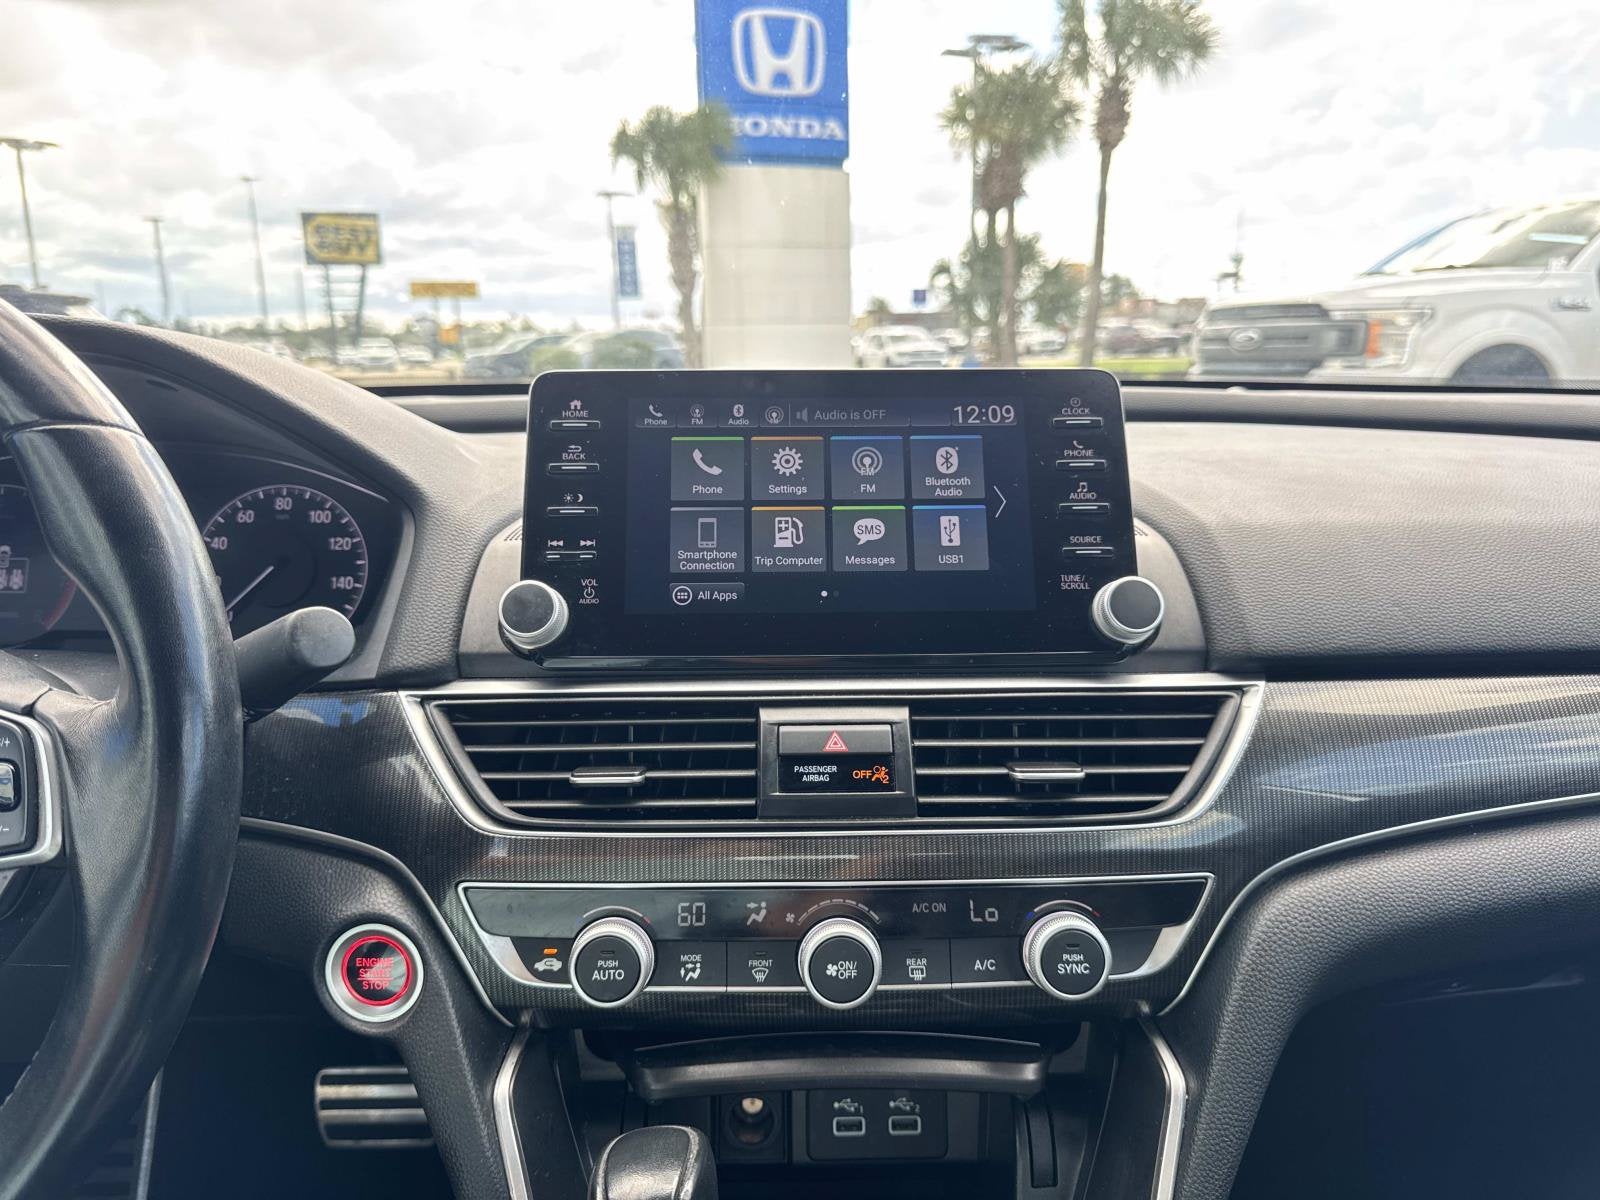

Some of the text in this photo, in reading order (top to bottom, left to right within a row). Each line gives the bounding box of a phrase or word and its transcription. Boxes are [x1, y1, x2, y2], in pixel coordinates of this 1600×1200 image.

[562, 410, 589, 418] HOME
[814, 409, 887, 420] Audio is OFF
[953, 405, 1015, 423] 12:09
[1061, 407, 1091, 415] CLOCK
[562, 452, 586, 461] BACK
[1063, 449, 1095, 457] PHONE
[925, 476, 971, 486] Bluetooth
[692, 484, 723, 494] Phone
[768, 484, 808, 496] Settings
[860, 484, 876, 493] FM
[934, 487, 963, 497] Audio
[1069, 492, 1097, 500] AUDIO
[274, 498, 292, 510] 80
[236, 510, 255, 523] 60
[308, 510, 332, 523] 100
[857, 524, 882, 535] SMS
[210, 537, 228, 550] 40
[328, 537, 352, 550] 120
[1069, 535, 1102, 544] SOURCE
[677, 549, 737, 561] Smartphone
[938, 555, 964, 564] USB1
[755, 556, 823, 567] Trip Computer
[845, 555, 896, 566] Messages
[679, 561, 735, 571] Connection
[1060, 574, 1085, 582] TUNE/
[330, 577, 354, 590] 140
[1060, 582, 1090, 590] SCROLL
[697, 590, 738, 602] All Apps
[794, 765, 837, 773] PASSENGER
[802, 774, 830, 782] AIRBAG
[852, 770, 873, 779] OFF
[912, 902, 947, 913] A/C ON
[677, 902, 706, 927] 60
[355, 957, 395, 967] ENGINE
[680, 954, 702, 962] MODE
[906, 958, 927, 967] REAR
[1062, 953, 1084, 962] PUSH
[597, 959, 619, 968] PUSH
[748, 959, 773, 967] FRONT
[837, 960, 858, 970] ON/
[974, 959, 996, 971] A/C
[1057, 962, 1090, 975] SYNC
[591, 969, 625, 981] AUTO
[837, 969, 858, 980] OFF
[362, 981, 391, 990] STOP
